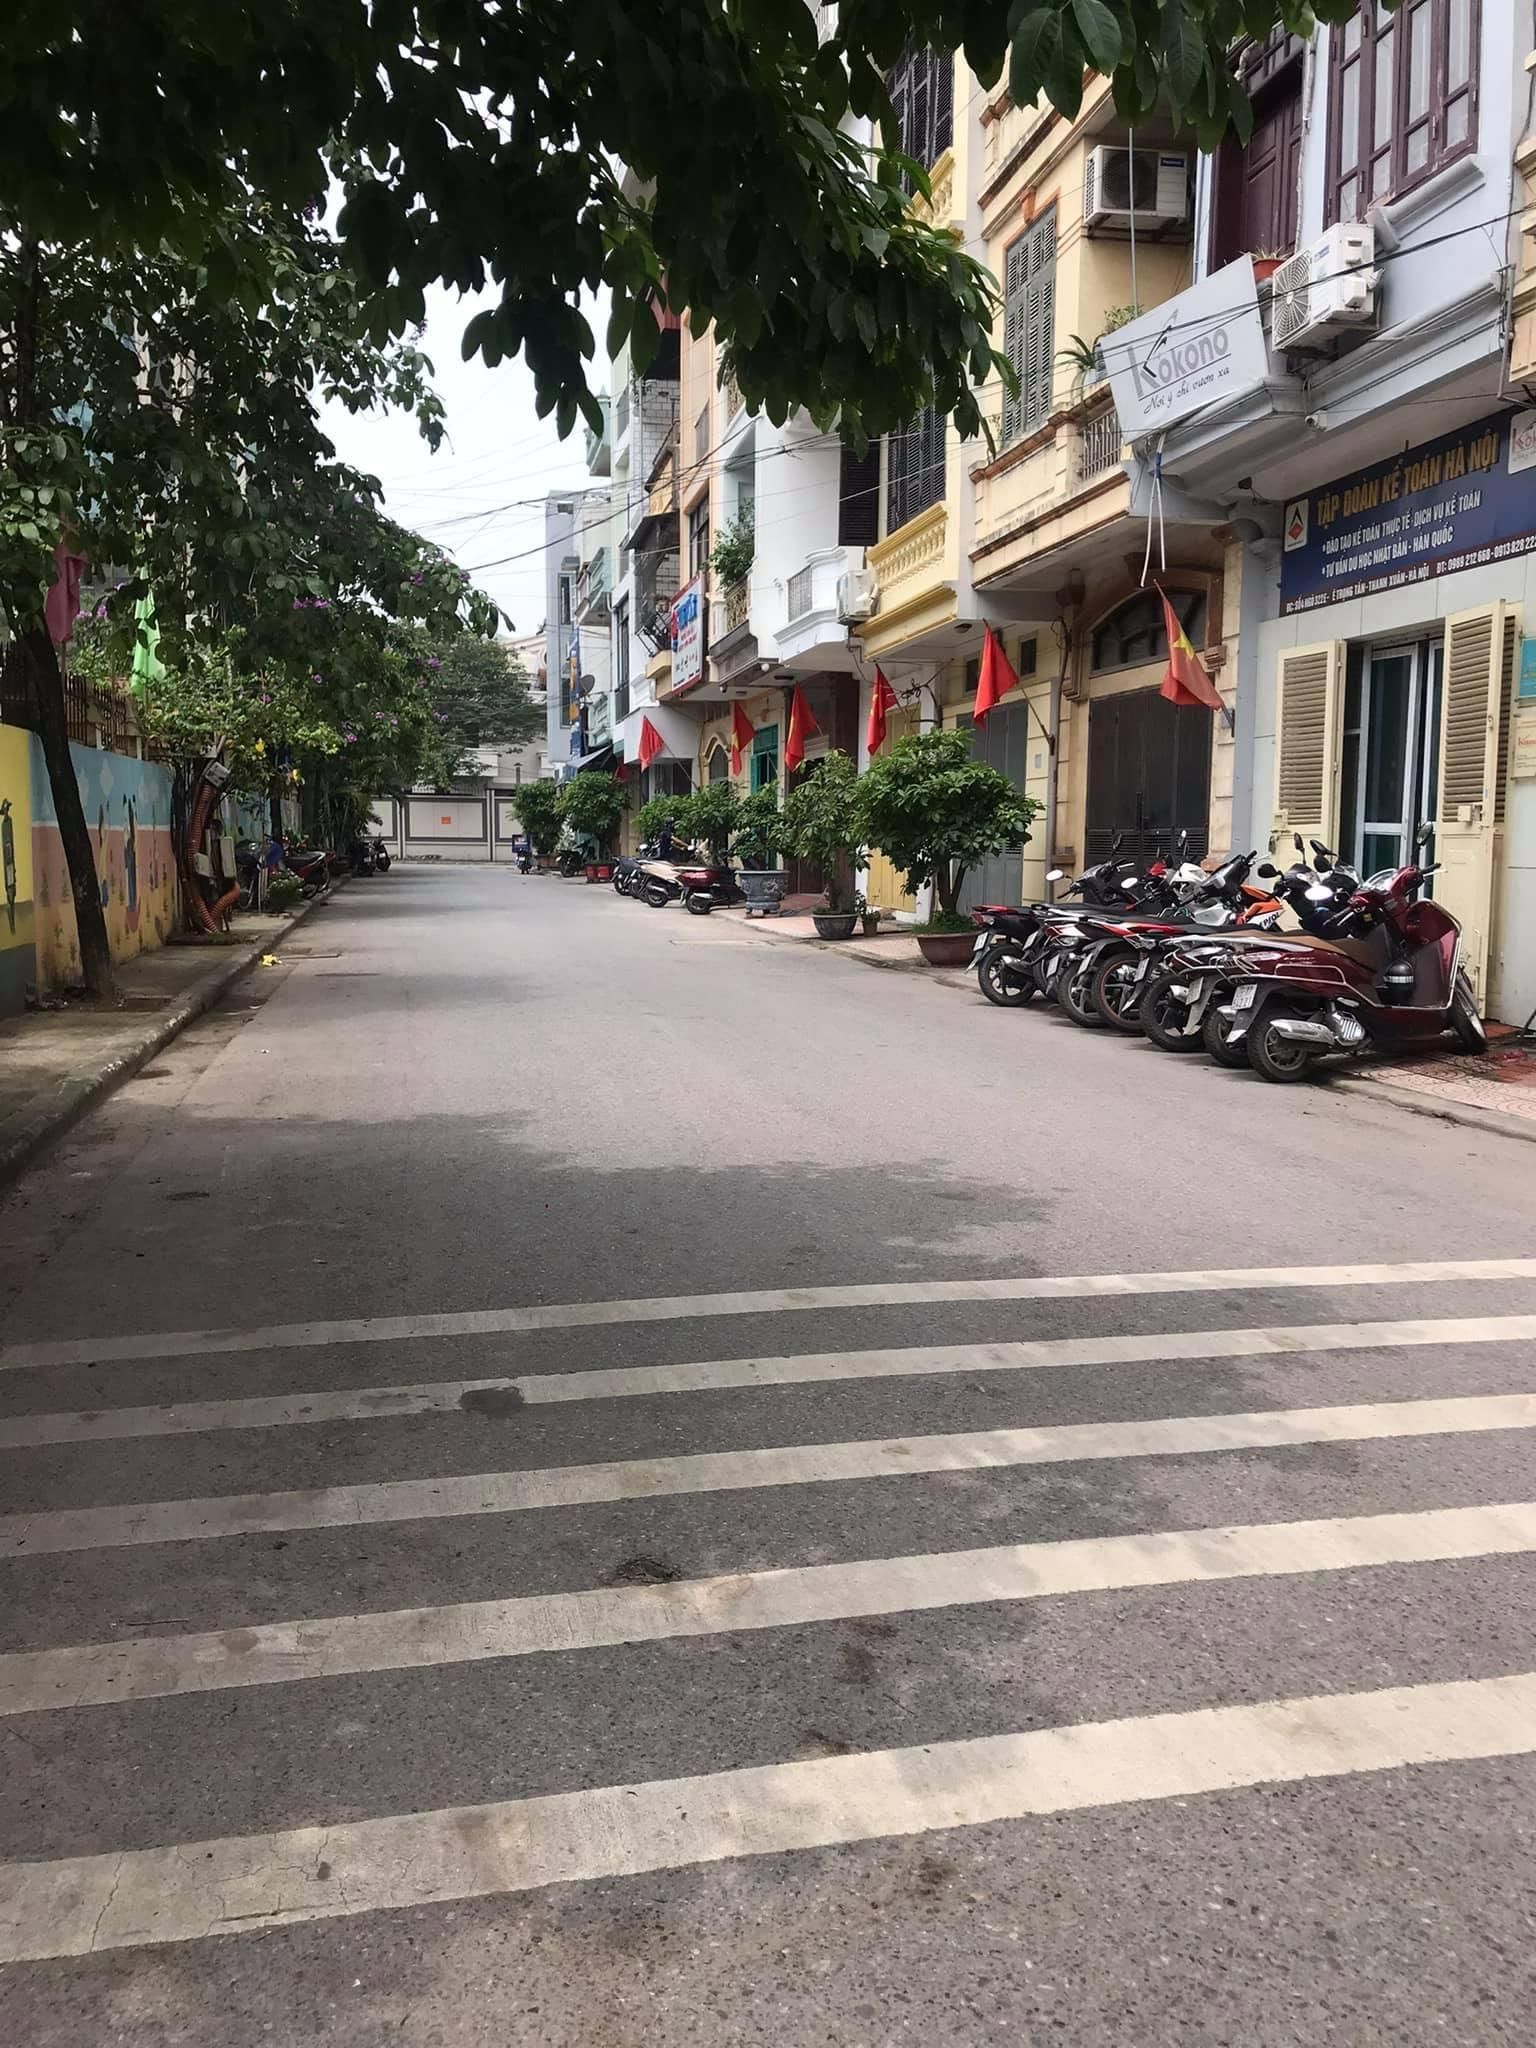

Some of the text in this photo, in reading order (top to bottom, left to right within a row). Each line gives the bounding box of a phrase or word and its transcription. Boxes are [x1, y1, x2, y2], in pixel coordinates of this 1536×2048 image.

[1127, 328, 1229, 398] Kokono
[1218, 367, 1230, 377] xa
[1404, 453, 1442, 496] TOÁN
[1444, 440, 1465, 480] HÀ
[1469, 427, 1498, 473] NỘI
[1362, 523, 1381, 543] TOÁN
[1402, 508, 1410, 530] TẾ
[1414, 507, 1433, 529] DỊCH
[1434, 502, 1445, 522] VỤ
[1445, 492, 1457, 517] KẾ
[1459, 489, 1481, 512] TOÁN
[1349, 557, 1358, 572] DU
[1359, 552, 1373, 570] HỌC
[1373, 544, 1392, 565] NHẬT
[1392, 537, 1408, 559] BẢN
[1413, 532, 1430, 552] HÀN
[1431, 521, 1454, 548] QUỐC
[1525, 535, 1536, 550] 22
